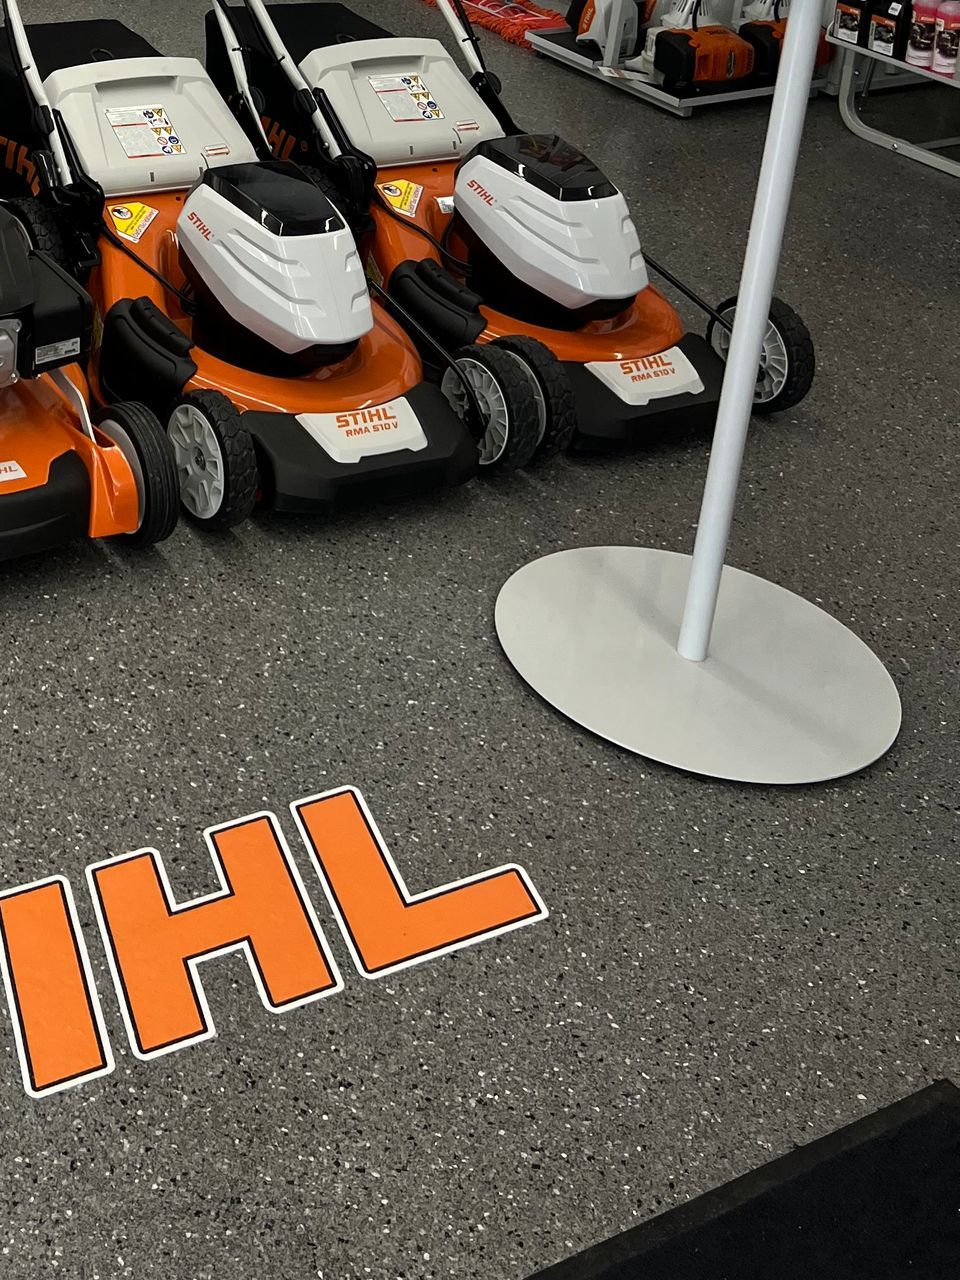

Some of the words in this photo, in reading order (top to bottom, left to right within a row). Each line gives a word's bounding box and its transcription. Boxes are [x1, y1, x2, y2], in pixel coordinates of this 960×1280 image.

[466, 179, 496, 206] STIHL
[187, 211, 212, 242] STIHL
[620, 355, 673, 375] STIHL
[630, 372, 653, 383] RMA
[653, 369, 669, 378] 510
[335, 407, 397, 429] STIHL
[345, 426, 371, 438] RMA
[372, 422, 391, 432] 510
[391, 421, 398, 429] V
